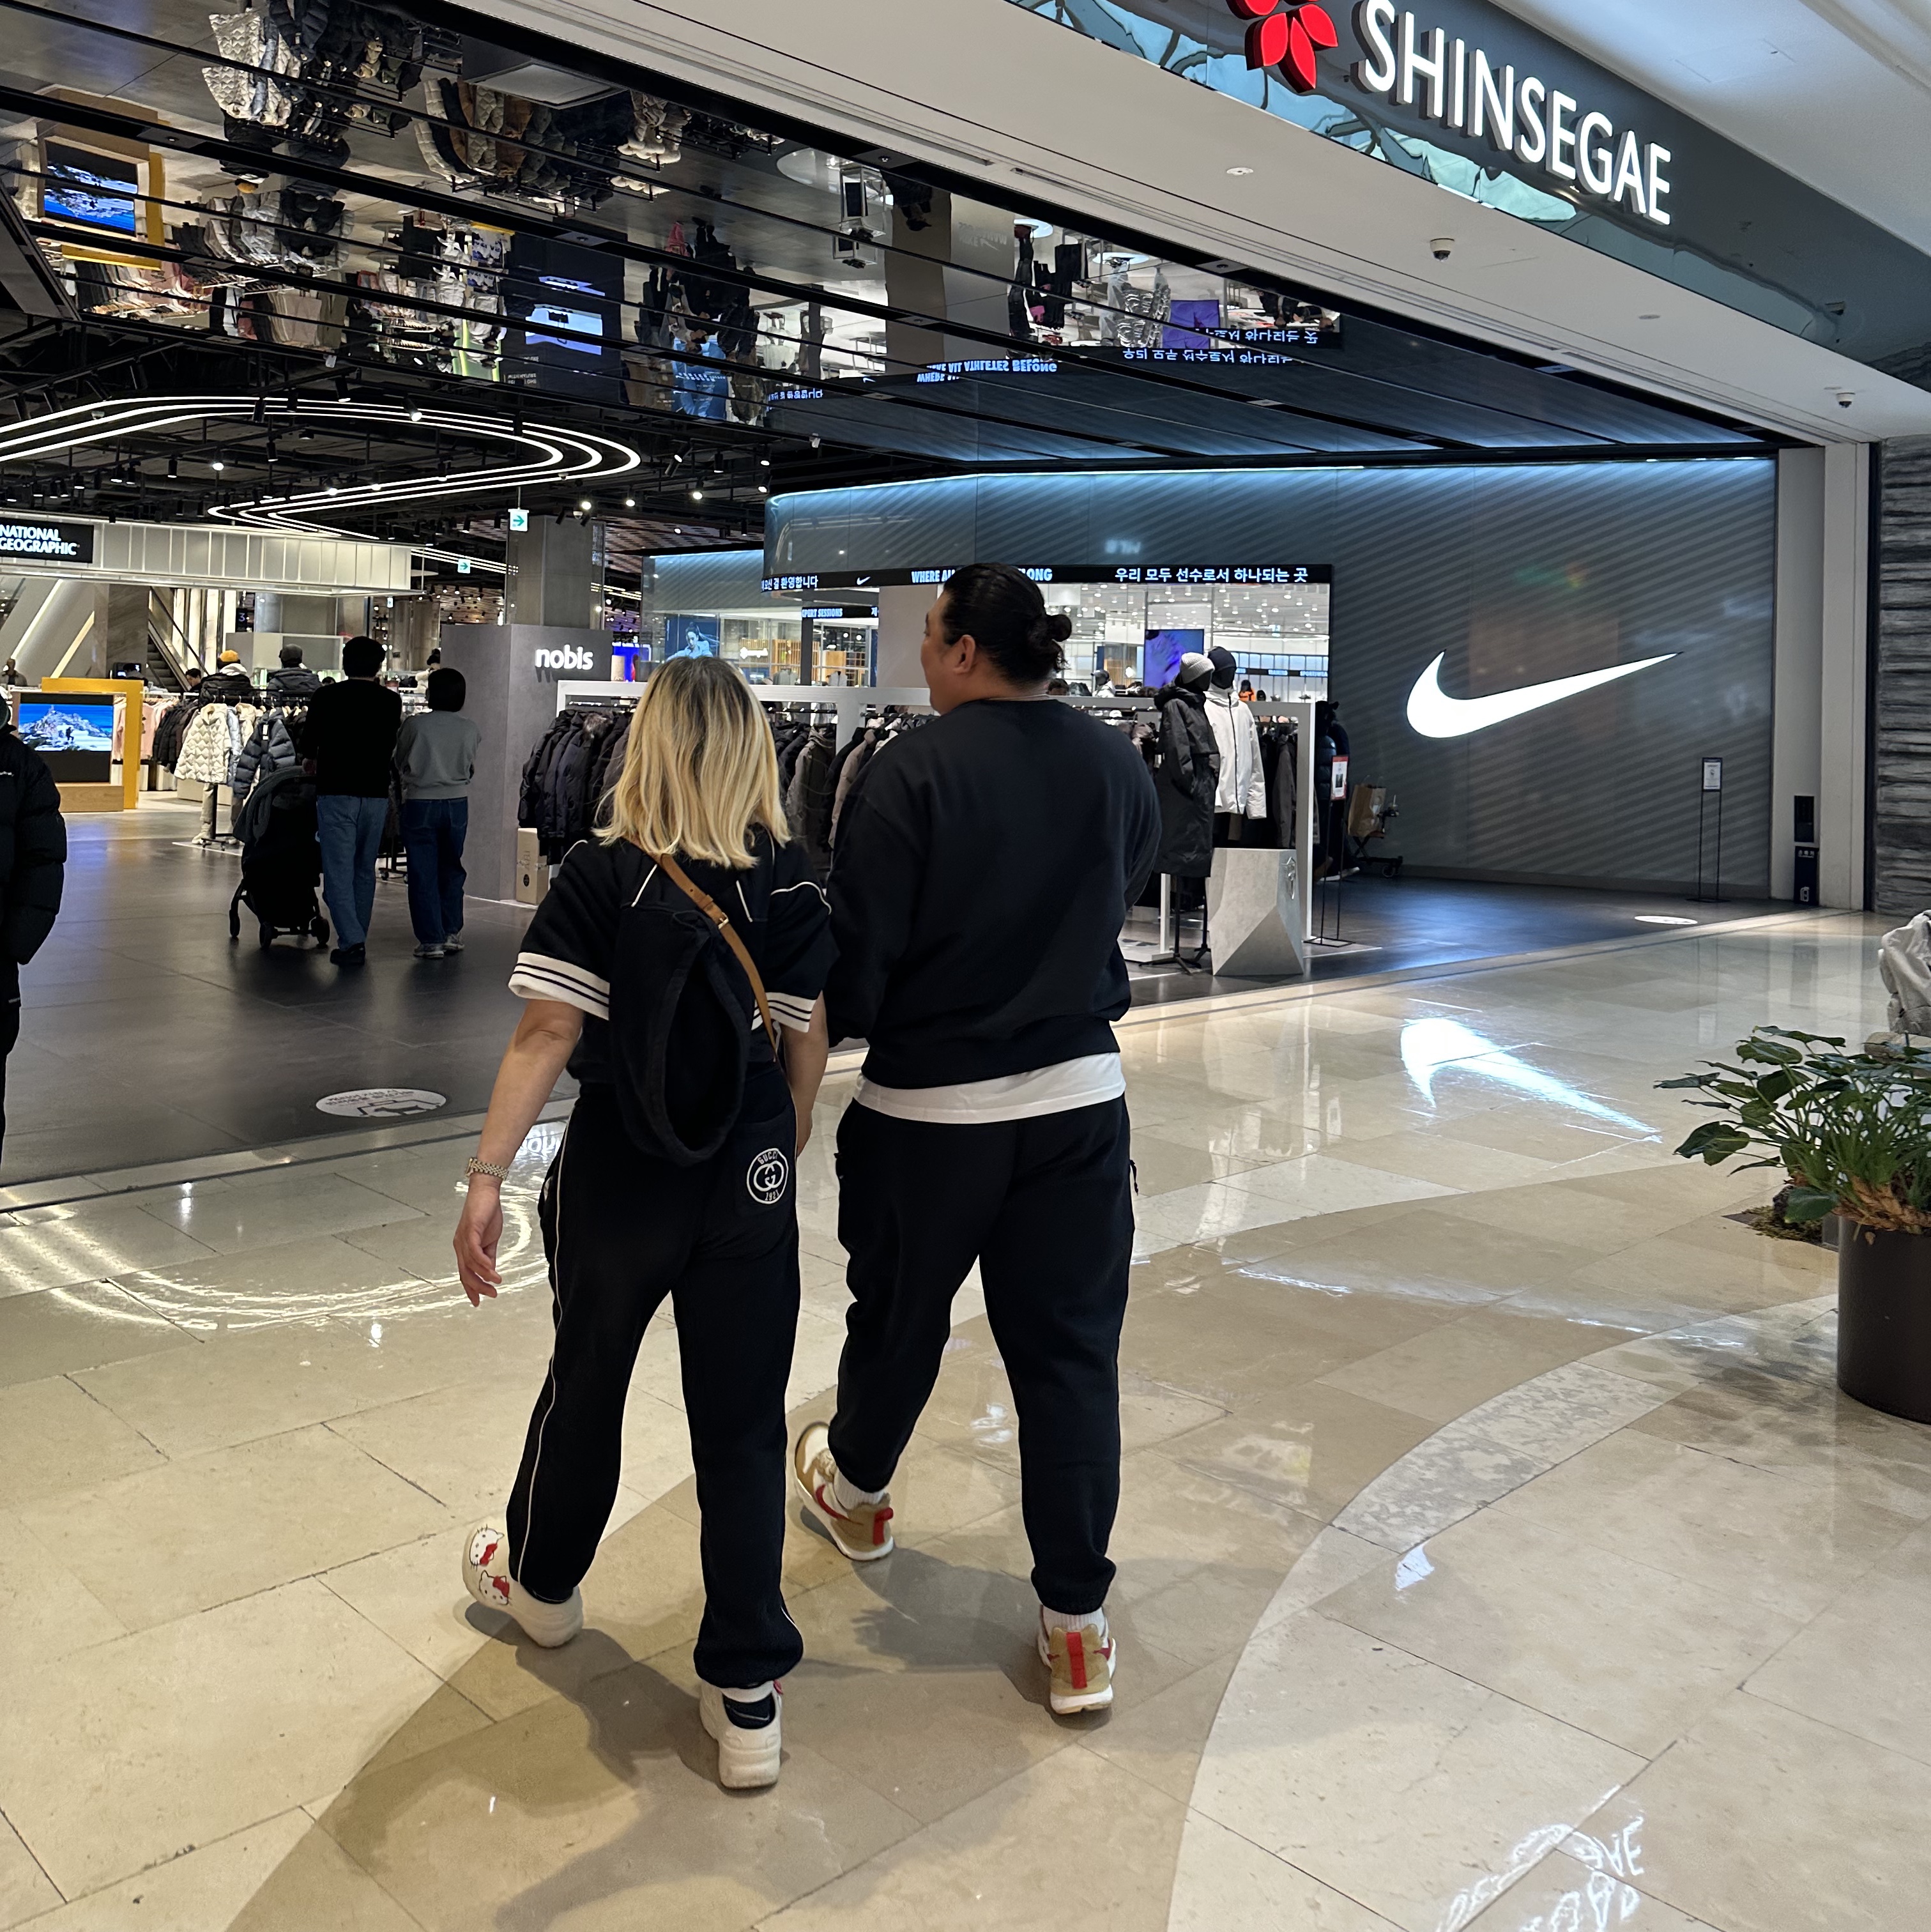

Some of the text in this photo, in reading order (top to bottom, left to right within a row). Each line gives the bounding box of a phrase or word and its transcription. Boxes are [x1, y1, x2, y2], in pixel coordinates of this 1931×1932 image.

[1361, 0, 1671, 226] SHINSEGAE
[0, 524, 62, 541] NATIONAL
[0, 537, 77, 556] GEOGRAPHIC
[781, 575, 818, 589] 환영합니다
[911, 570, 940, 583] WHERE
[1115, 567, 1308, 583] 우리 모두 선수로서 하나되는 곳
[238, 612, 245, 622] 3
[535, 644, 593, 670] nobis
[758, 1151, 778, 1165] GUCCI
[765, 1189, 779, 1201] 1921
